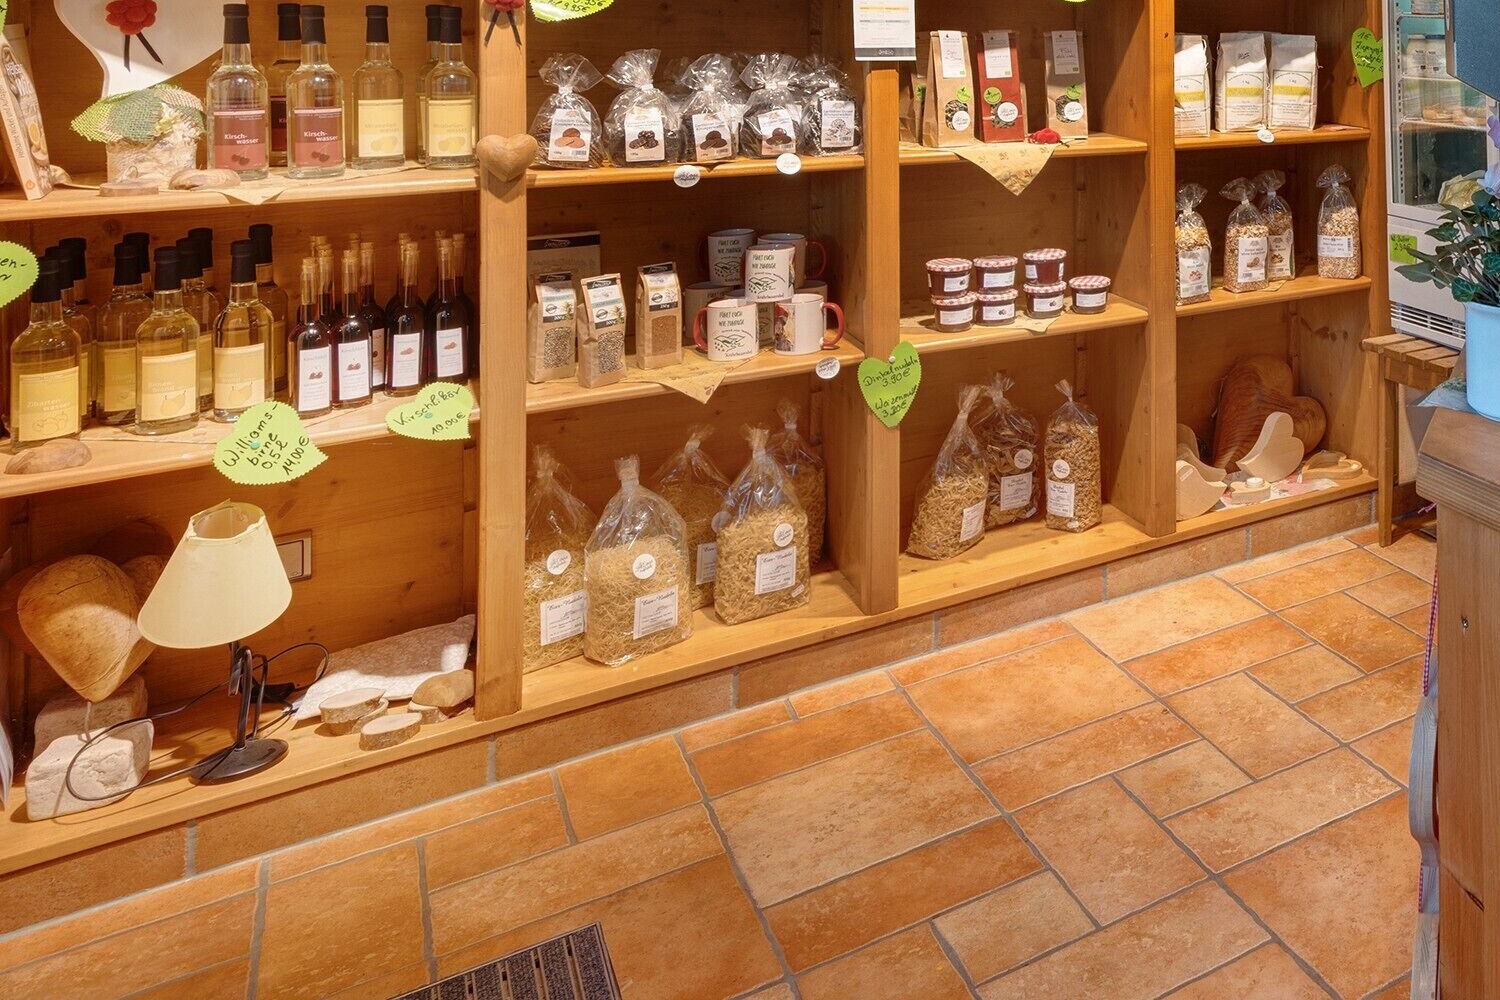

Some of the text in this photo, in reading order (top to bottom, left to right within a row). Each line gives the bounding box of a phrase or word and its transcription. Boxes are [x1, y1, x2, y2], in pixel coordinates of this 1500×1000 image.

[224, 132, 248, 140] Kirsch-
[303, 130, 328, 138] Kirsch-
[247, 432, 278, 466] birne
